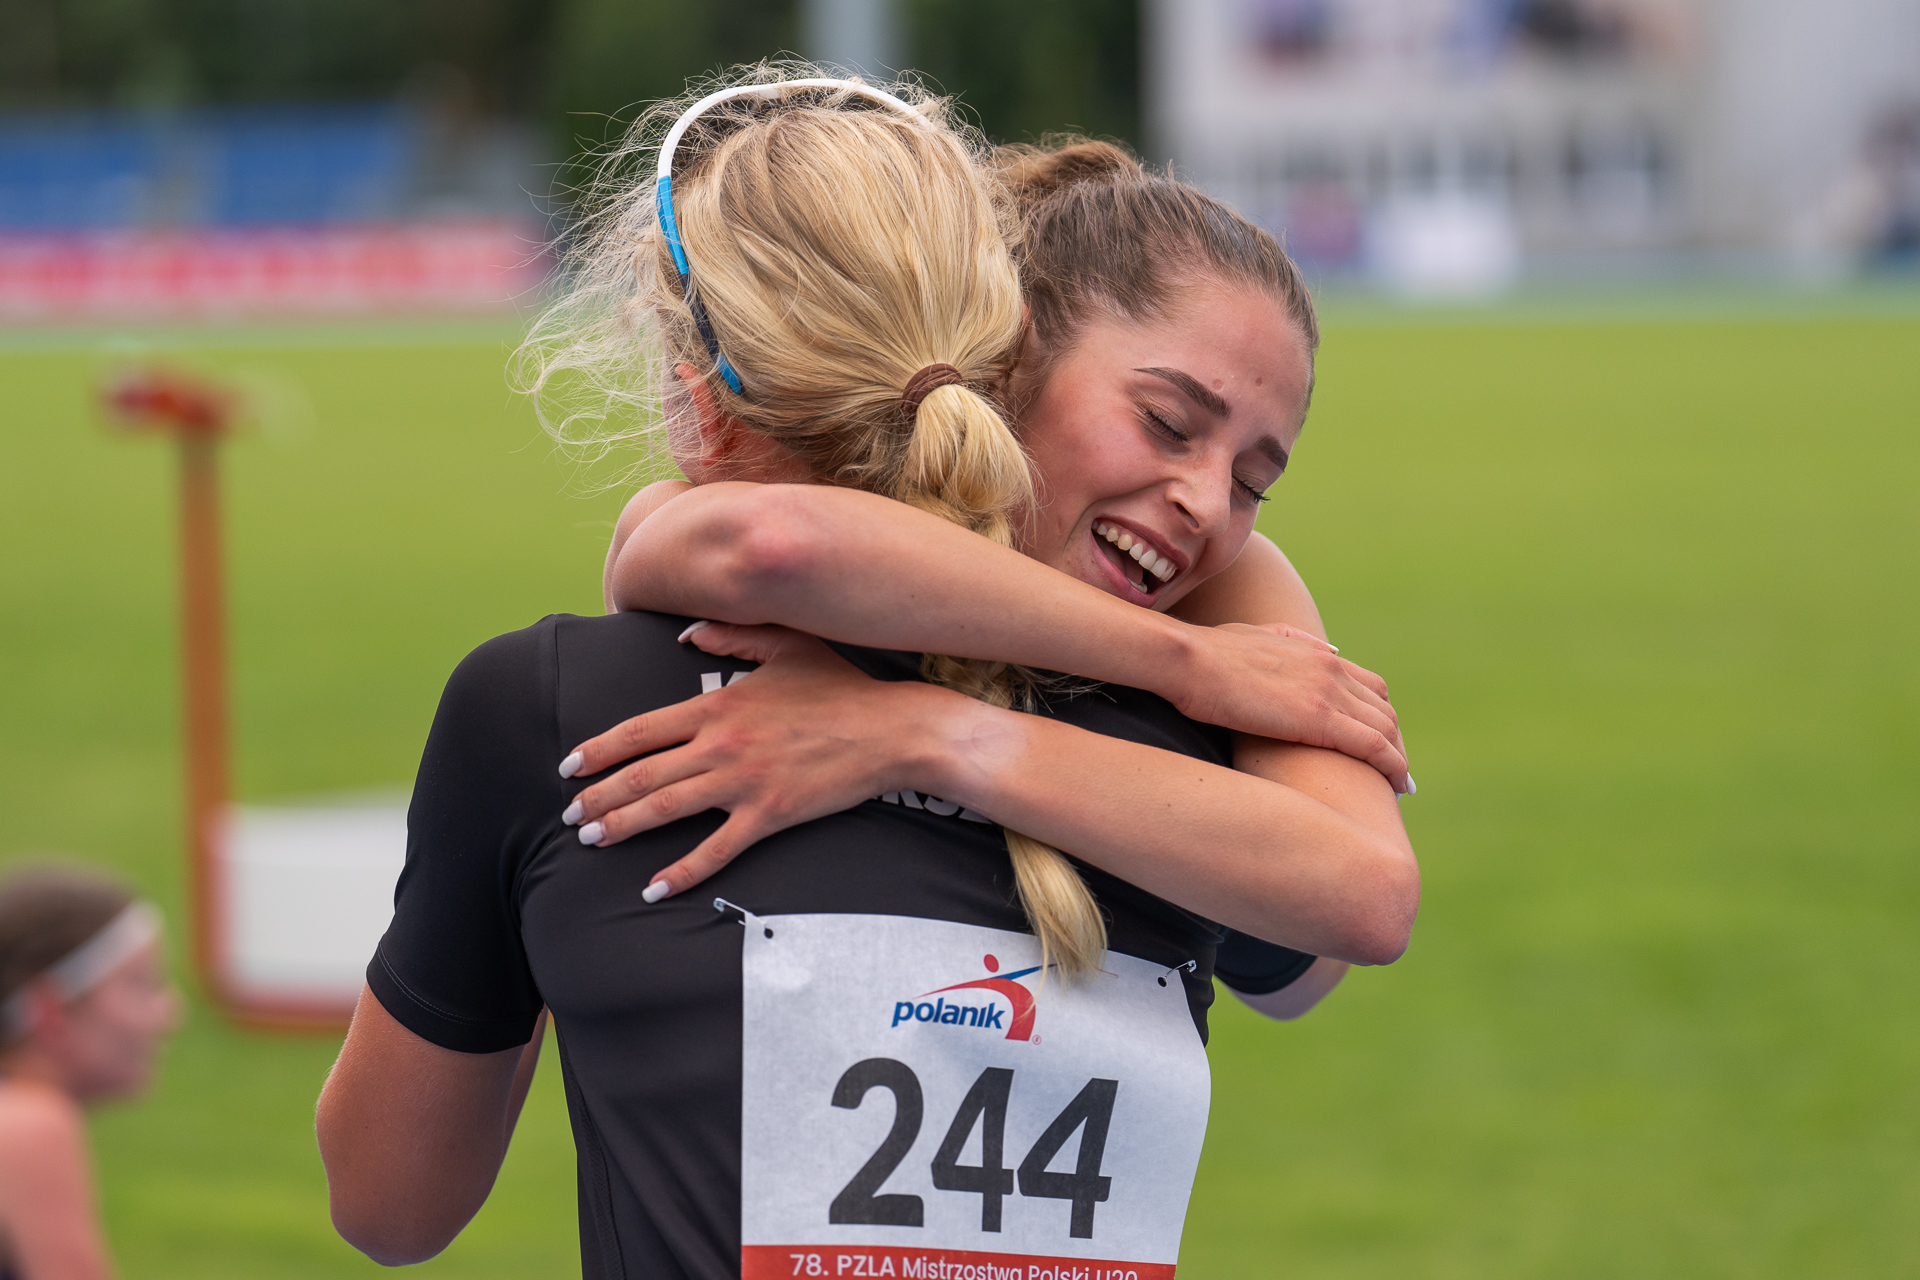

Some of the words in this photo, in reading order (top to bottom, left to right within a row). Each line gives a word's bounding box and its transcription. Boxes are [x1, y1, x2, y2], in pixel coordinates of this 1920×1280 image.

[891, 997, 1006, 1030] polanik
[829, 1057, 1119, 1239] 244
[789, 1253, 829, 1277] 78.
[837, 1254, 896, 1278] PZLA
[902, 1256, 1022, 1280] Mistrzostwa
[1028, 1265, 1090, 1280] Polski
